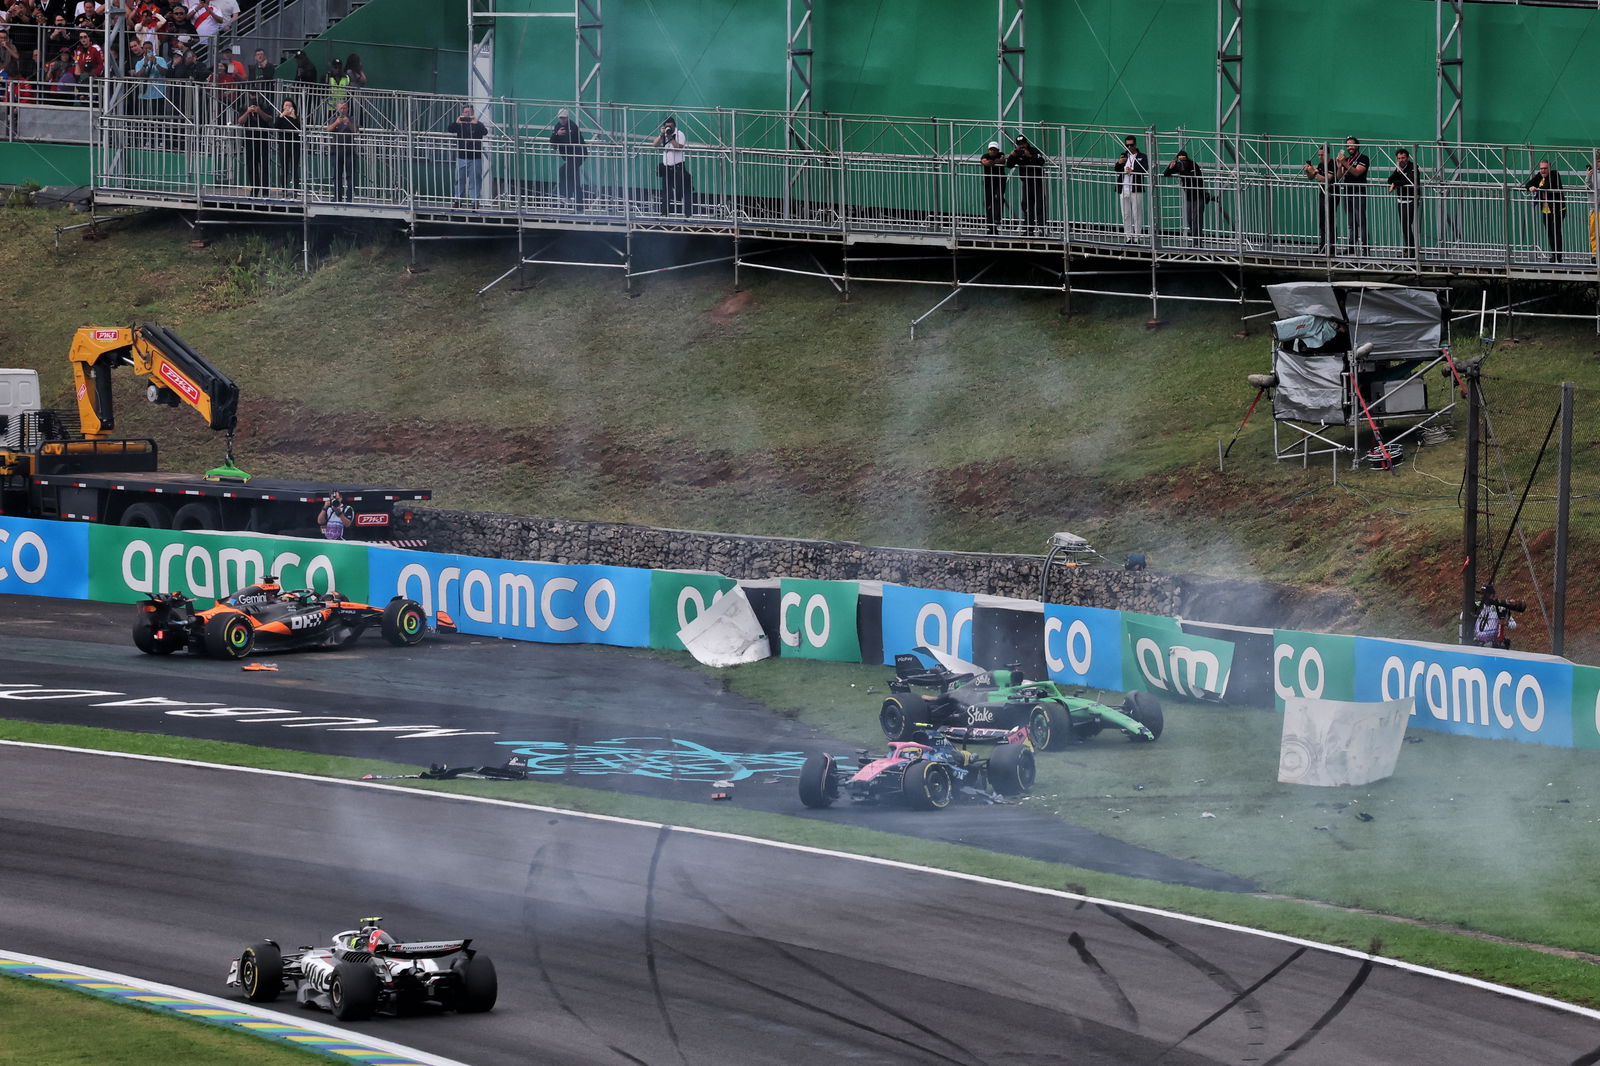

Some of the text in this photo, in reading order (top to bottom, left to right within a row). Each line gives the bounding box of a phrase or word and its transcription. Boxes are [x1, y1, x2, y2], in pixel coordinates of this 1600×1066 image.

[0, 528, 48, 584] o
[122, 540, 335, 599] aramco
[238, 592, 267, 605] Gemini
[397, 563, 617, 632] aramco
[1136, 637, 1231, 699] am
[1381, 655, 1545, 733] aramco
[0, 683, 500, 738] MUBAD
[966, 704, 994, 726] Stake
